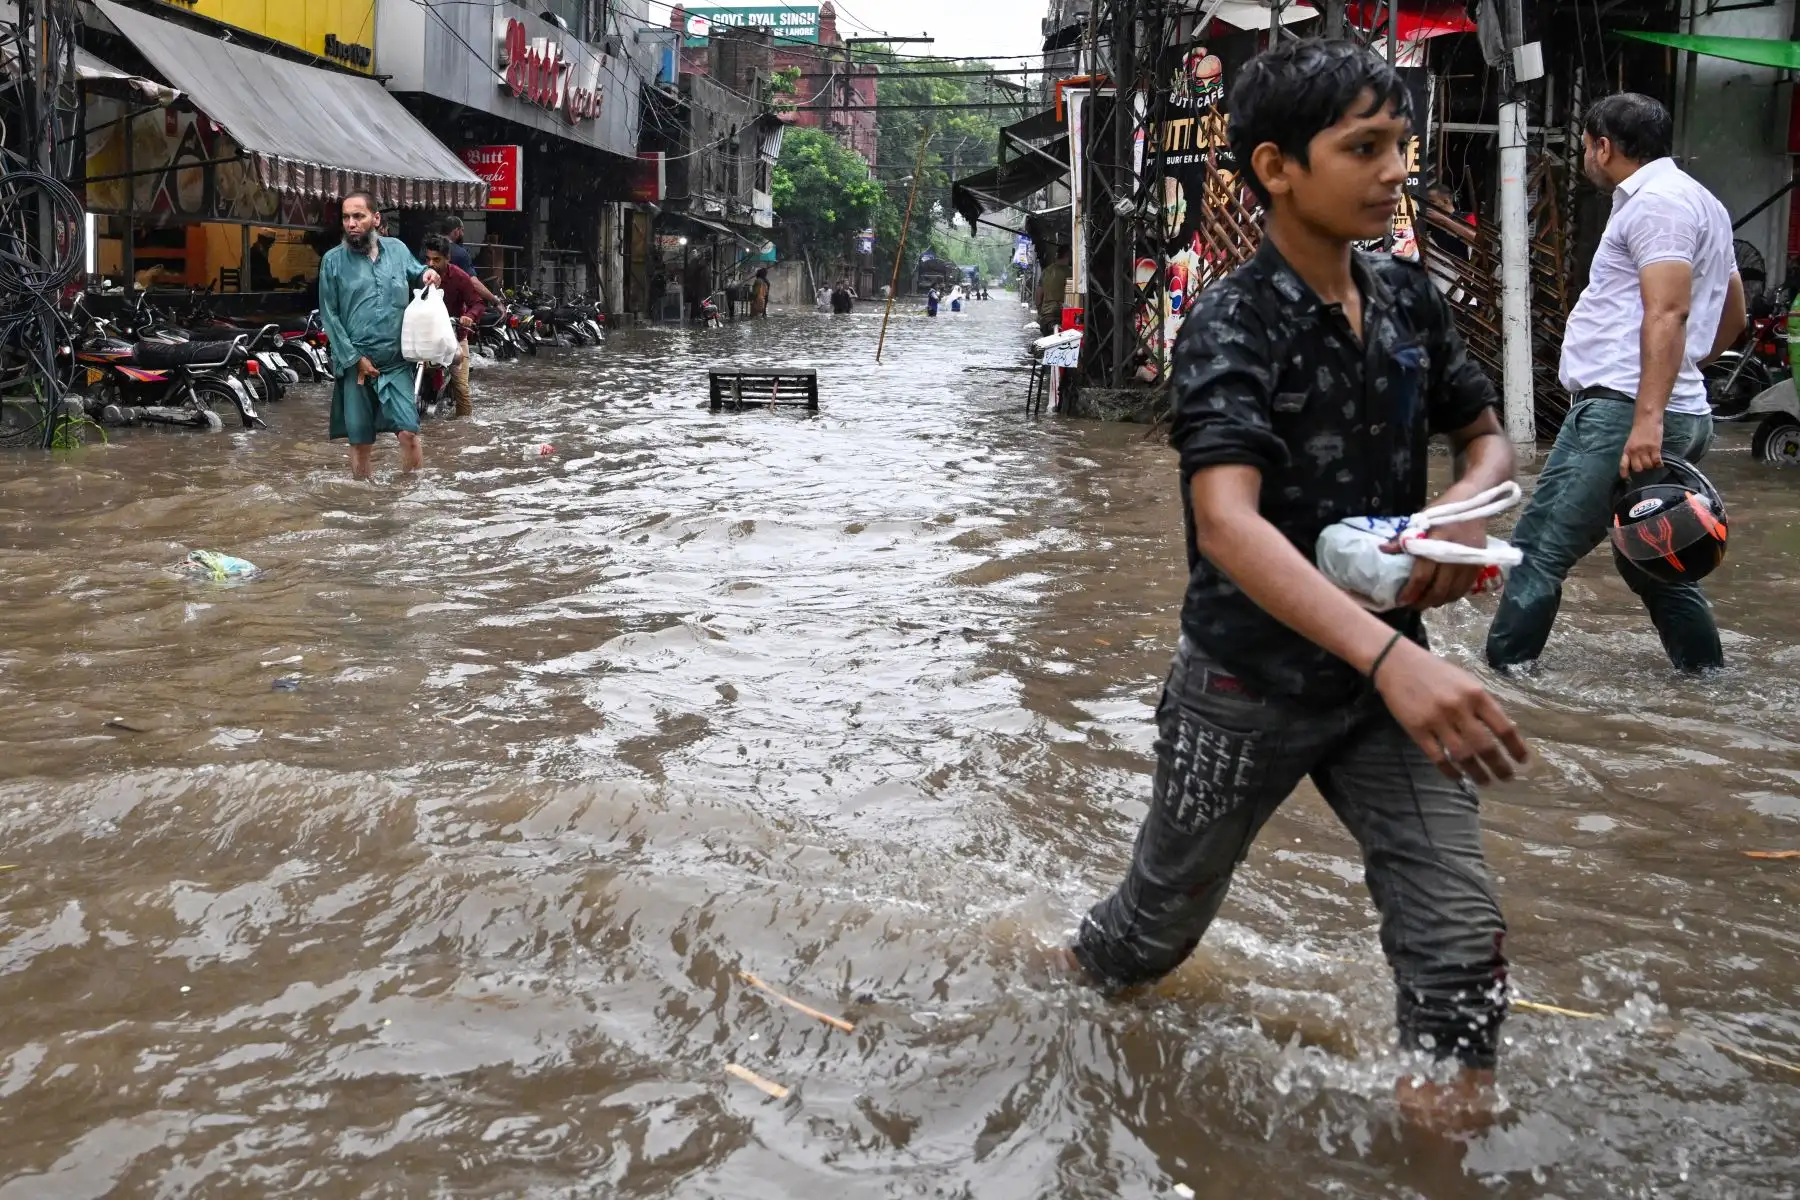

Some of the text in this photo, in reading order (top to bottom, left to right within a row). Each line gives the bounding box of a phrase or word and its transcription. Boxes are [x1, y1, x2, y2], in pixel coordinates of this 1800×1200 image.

[748, 13, 777, 26] DYAL
[780, 12, 816, 26] SINGH
[786, 27, 814, 37] LAHORE
[466, 149, 504, 165] Butt
[1200, 152, 1219, 162] FAT
[471, 161, 509, 182] arahi
[1392, 217, 1408, 225] UTT
